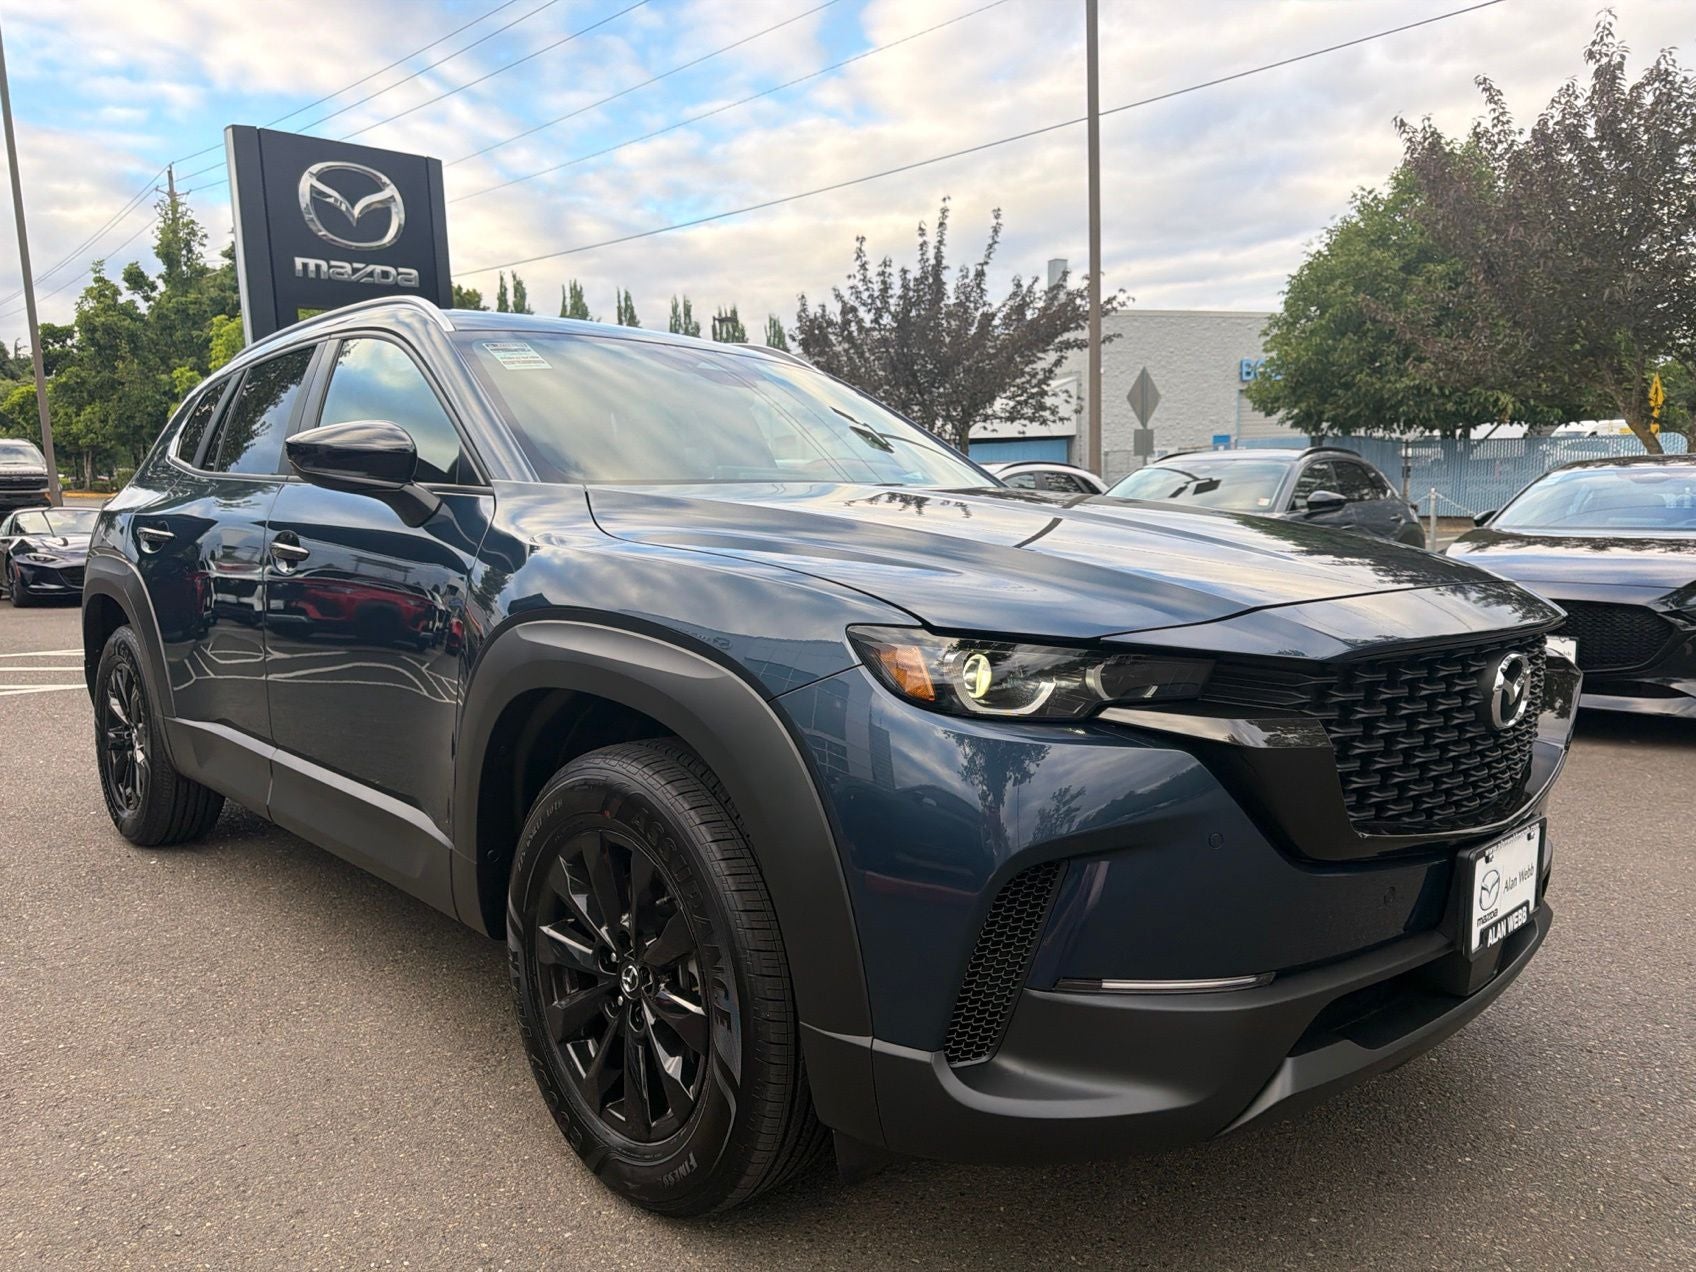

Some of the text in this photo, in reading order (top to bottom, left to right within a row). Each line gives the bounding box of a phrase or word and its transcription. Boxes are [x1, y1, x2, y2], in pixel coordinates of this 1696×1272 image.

[1504, 863, 1534, 893] Alan Webb
[1487, 905, 1528, 948] ALAN WEBB
